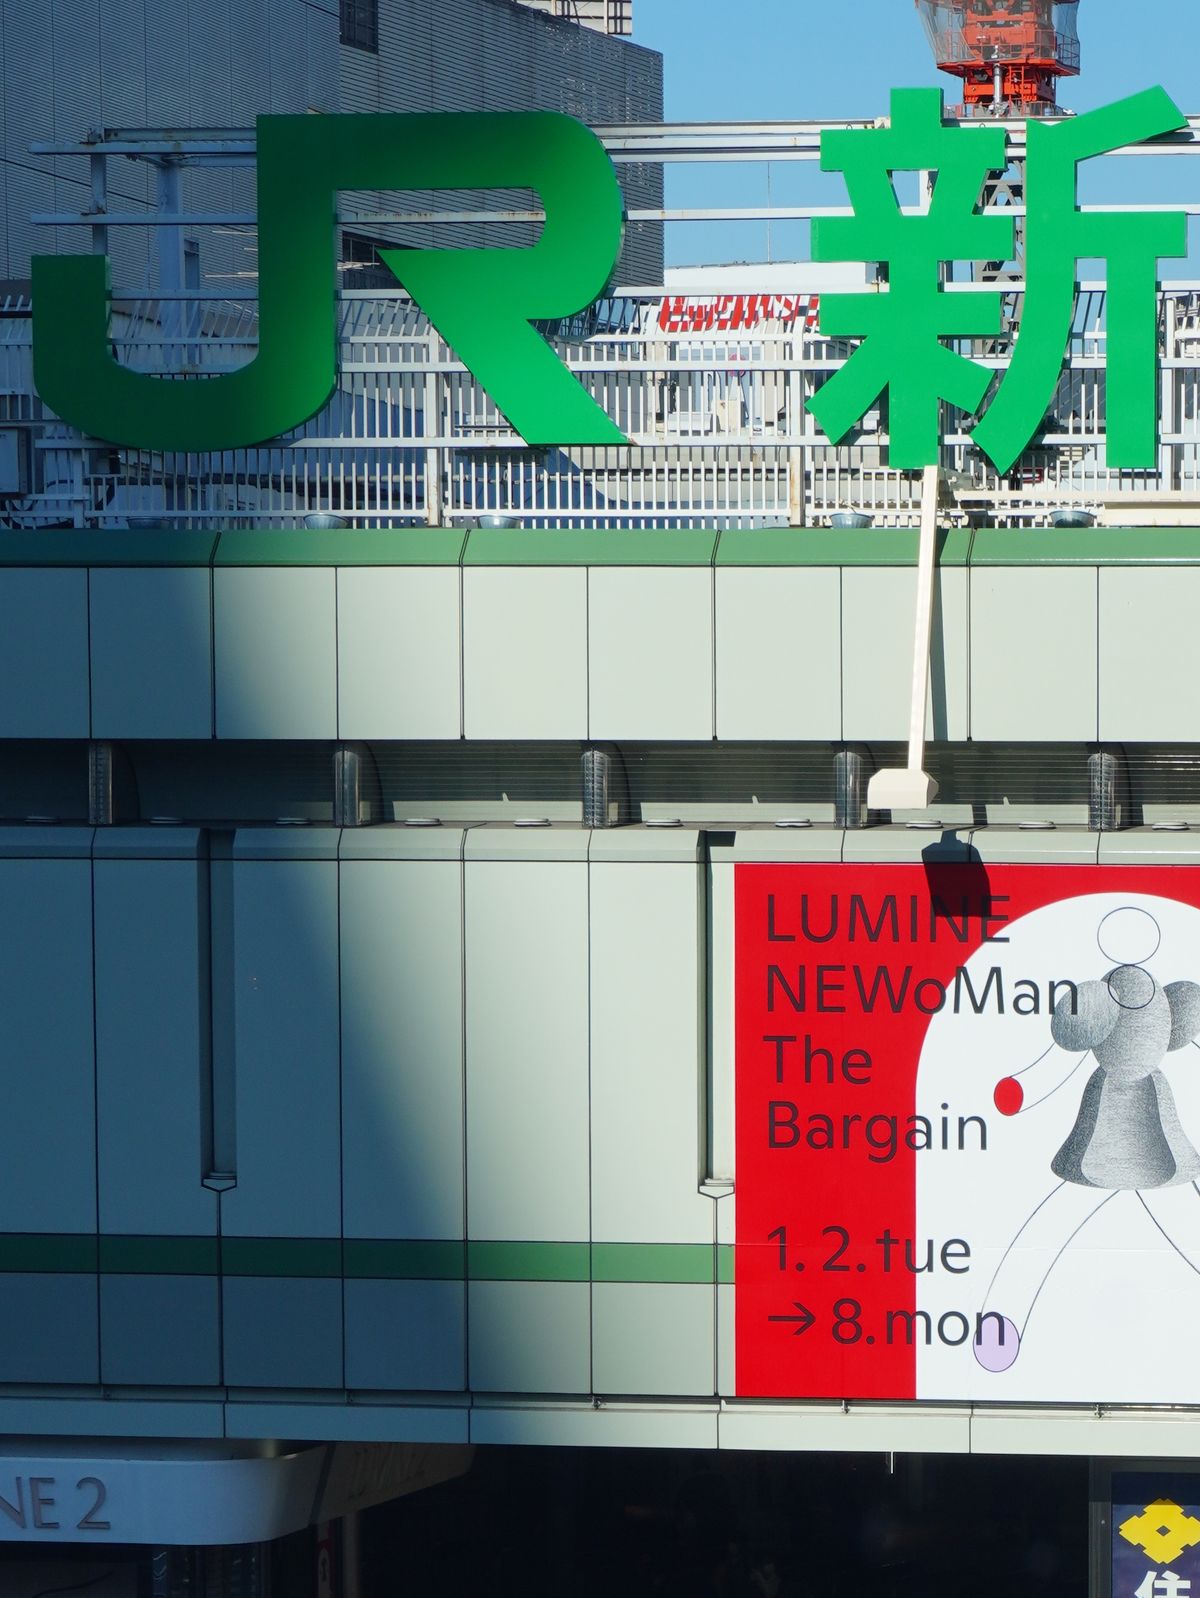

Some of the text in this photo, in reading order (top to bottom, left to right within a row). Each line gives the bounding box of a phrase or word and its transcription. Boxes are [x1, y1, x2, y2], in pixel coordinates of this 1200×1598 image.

[31, 112, 632, 452] JR
[766, 893, 1011, 943] LUMINE
[766, 965, 1079, 1016] NEWoMan
[764, 1035, 872, 1085] The
[766, 1102, 988, 1163] Bargain
[76, 1476, 111, 1531] 2
